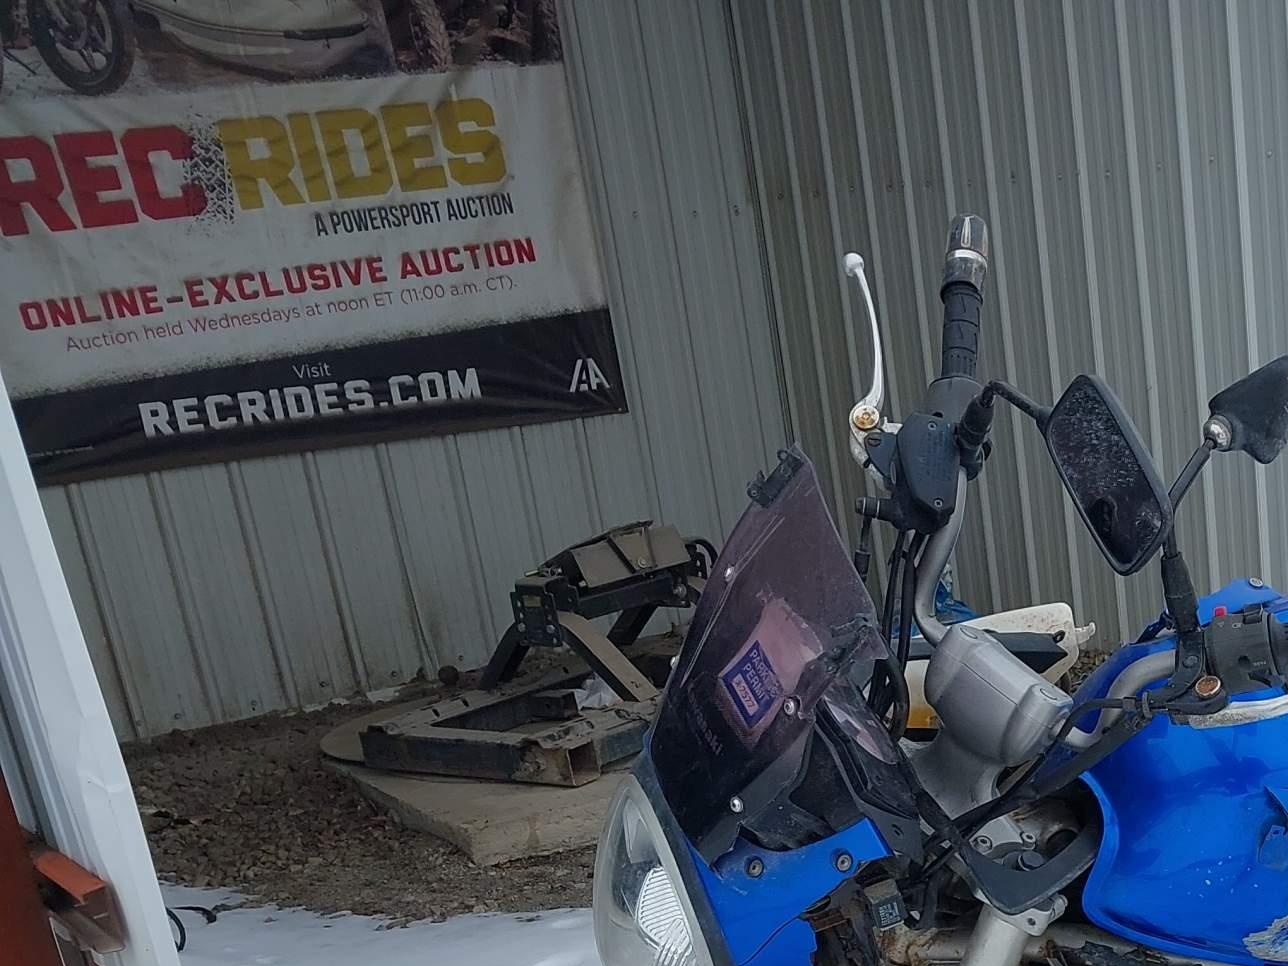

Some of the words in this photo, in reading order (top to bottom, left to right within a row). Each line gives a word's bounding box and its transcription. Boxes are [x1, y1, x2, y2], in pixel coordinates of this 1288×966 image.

[0, 125, 208, 237] REC
[216, 97, 507, 210] RIDES
[315, 211, 329, 236] A
[332, 200, 442, 233] POWERSPORT
[447, 193, 514, 221] AUCTION
[19, 256, 388, 332] ONLINE-EXCLUSIVE
[400, 237, 537, 279] AUCTION
[66, 329, 139, 352] Auction
[144, 319, 184, 341] held
[188, 307, 300, 334] Wednesdays
[306, 301, 322, 317] at
[327, 296, 369, 314] noon
[374, 291, 394, 308] ET
[400, 283, 446, 304] (11:00
[450, 282, 481, 297] a.m.
[486, 275, 517, 292] CT).
[138, 367, 483, 439] RECRIDES.COM
[292, 361, 331, 380] Visit
[749, 648, 778, 698] PARKG
